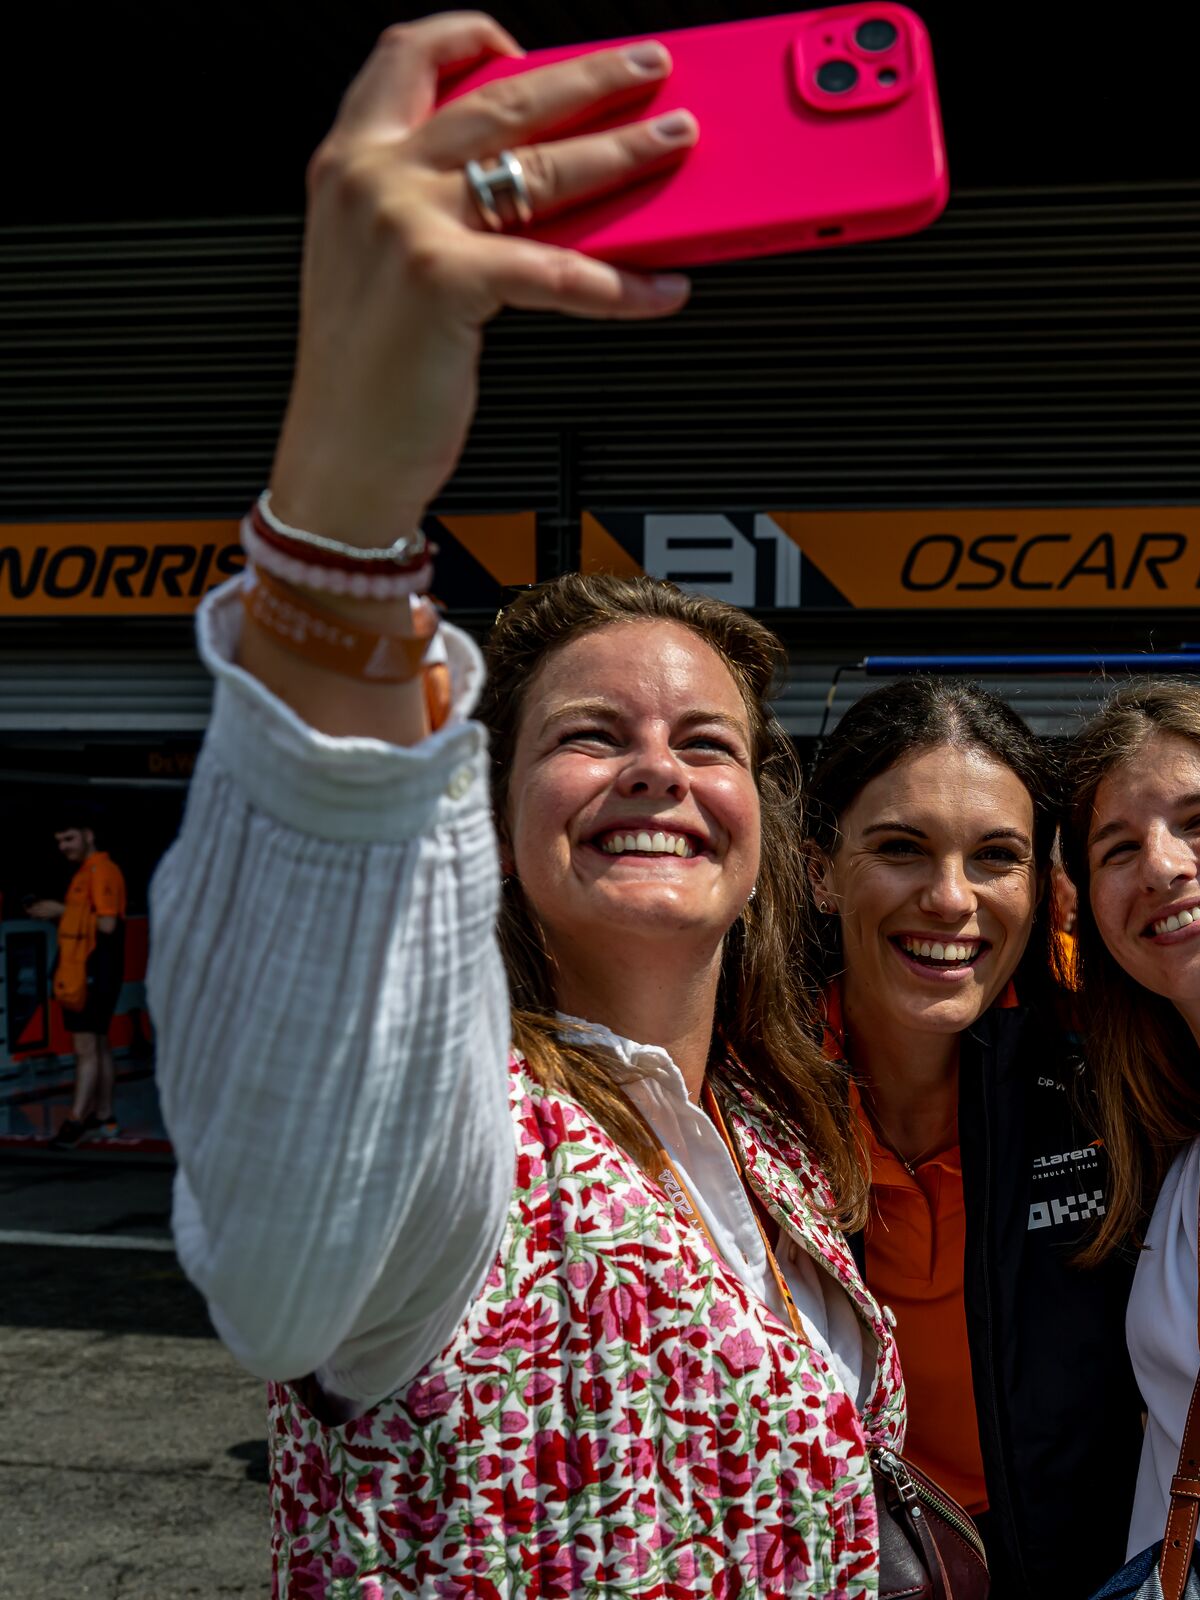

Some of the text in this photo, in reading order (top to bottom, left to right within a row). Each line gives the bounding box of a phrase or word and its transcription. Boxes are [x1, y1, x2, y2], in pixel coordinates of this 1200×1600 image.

[901, 532, 1188, 591] OSCAR
[658, 1168, 694, 1215] 2024
[1032, 1168, 1065, 1181] ORMULA
[1077, 1162, 1098, 1171] TEAM
